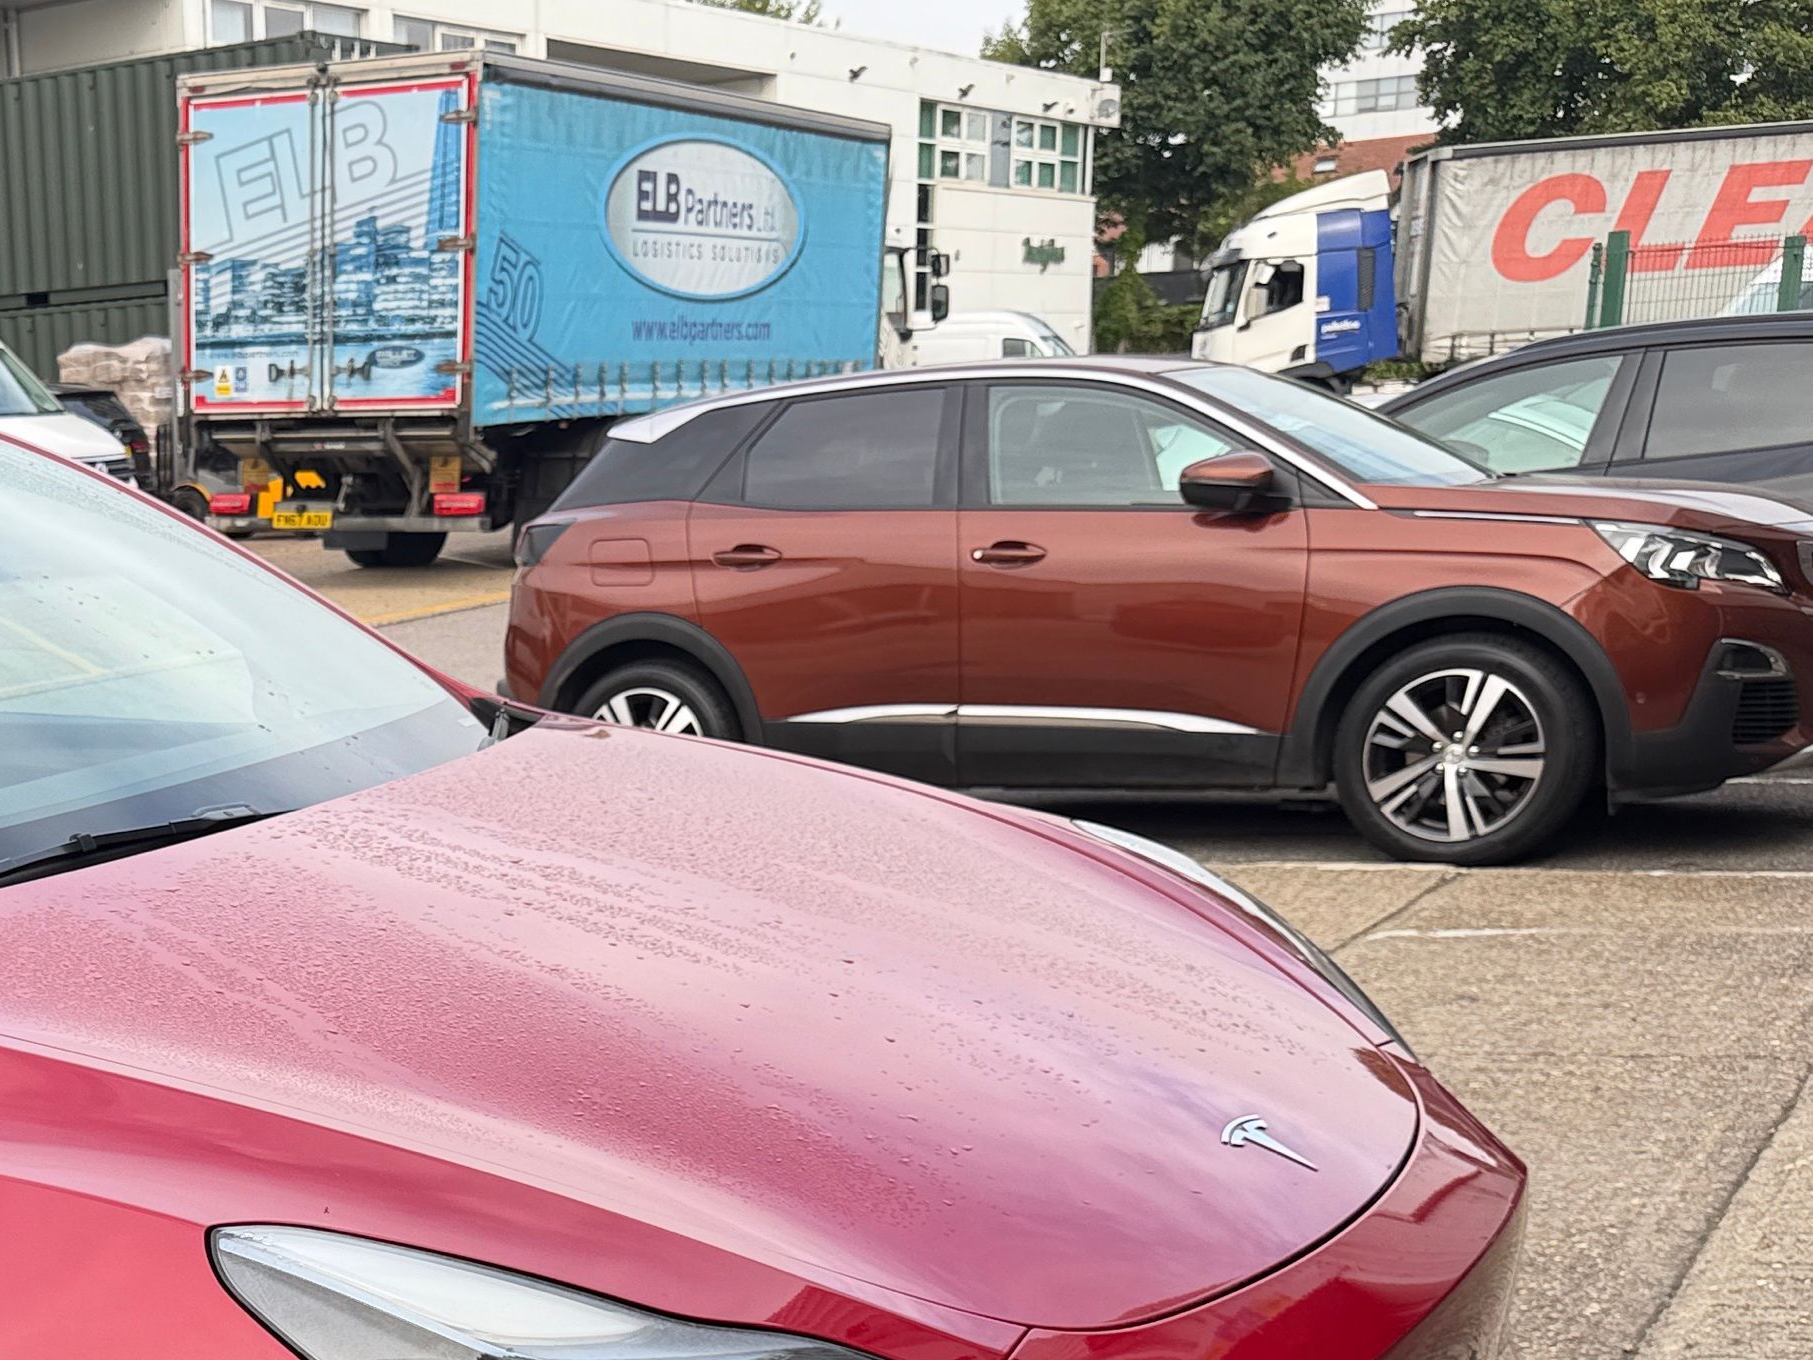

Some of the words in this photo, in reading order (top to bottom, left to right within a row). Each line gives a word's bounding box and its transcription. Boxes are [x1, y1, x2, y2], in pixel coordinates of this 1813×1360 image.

[214, 100, 398, 242] ELB
[636, 169, 681, 224] ELB
[684, 188, 755, 232] Partners
[632, 239, 703, 261] LOGISTICS
[711, 243, 780, 265] SOLUTIONS
[1490, 159, 1813, 282] CLE
[487, 236, 545, 342] 50
[632, 315, 771, 345] www.elbpartners.com
